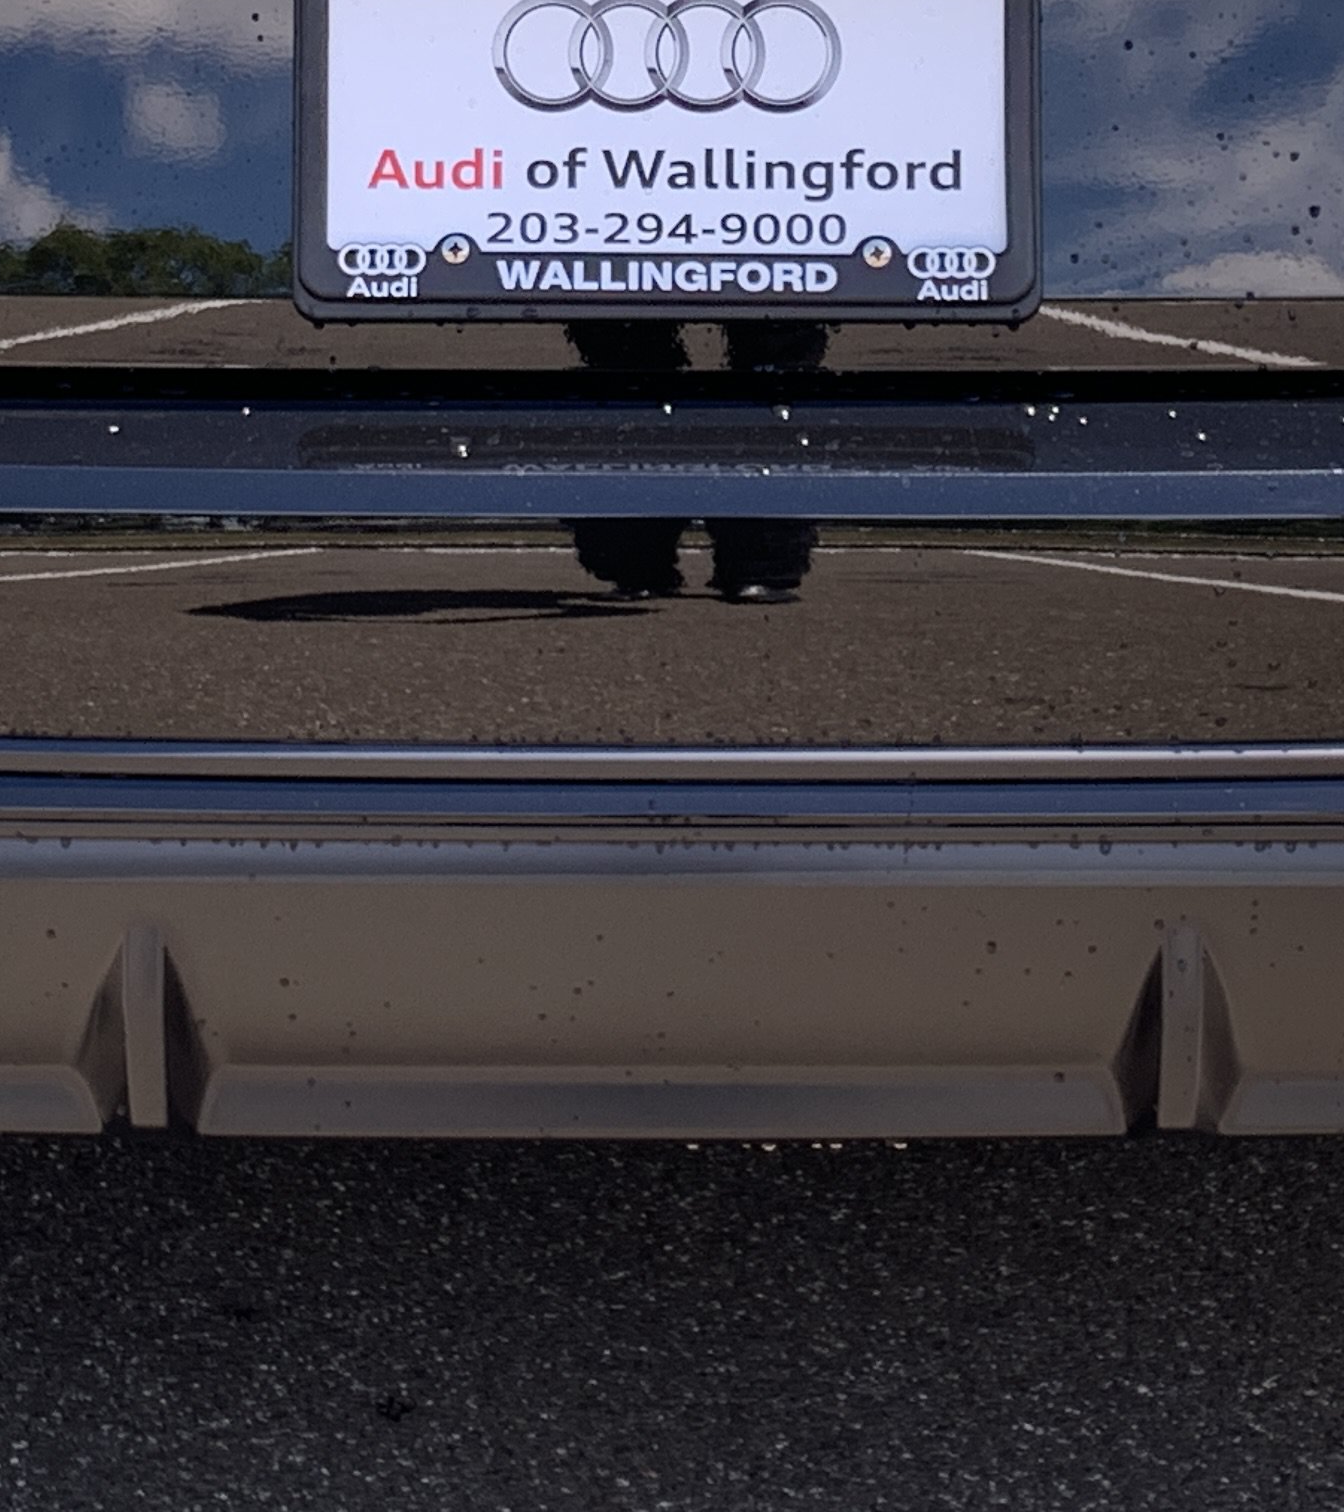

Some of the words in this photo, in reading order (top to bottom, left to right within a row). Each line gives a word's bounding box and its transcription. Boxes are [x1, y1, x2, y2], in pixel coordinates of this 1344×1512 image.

[368, 148, 504, 191] Audi
[525, 148, 587, 191] of
[603, 148, 964, 202] Wallingford
[486, 211, 848, 247] 203-294-9000
[346, 275, 419, 299] Audi
[497, 260, 839, 293] WALLINGFORD
[917, 278, 990, 303] Audi
